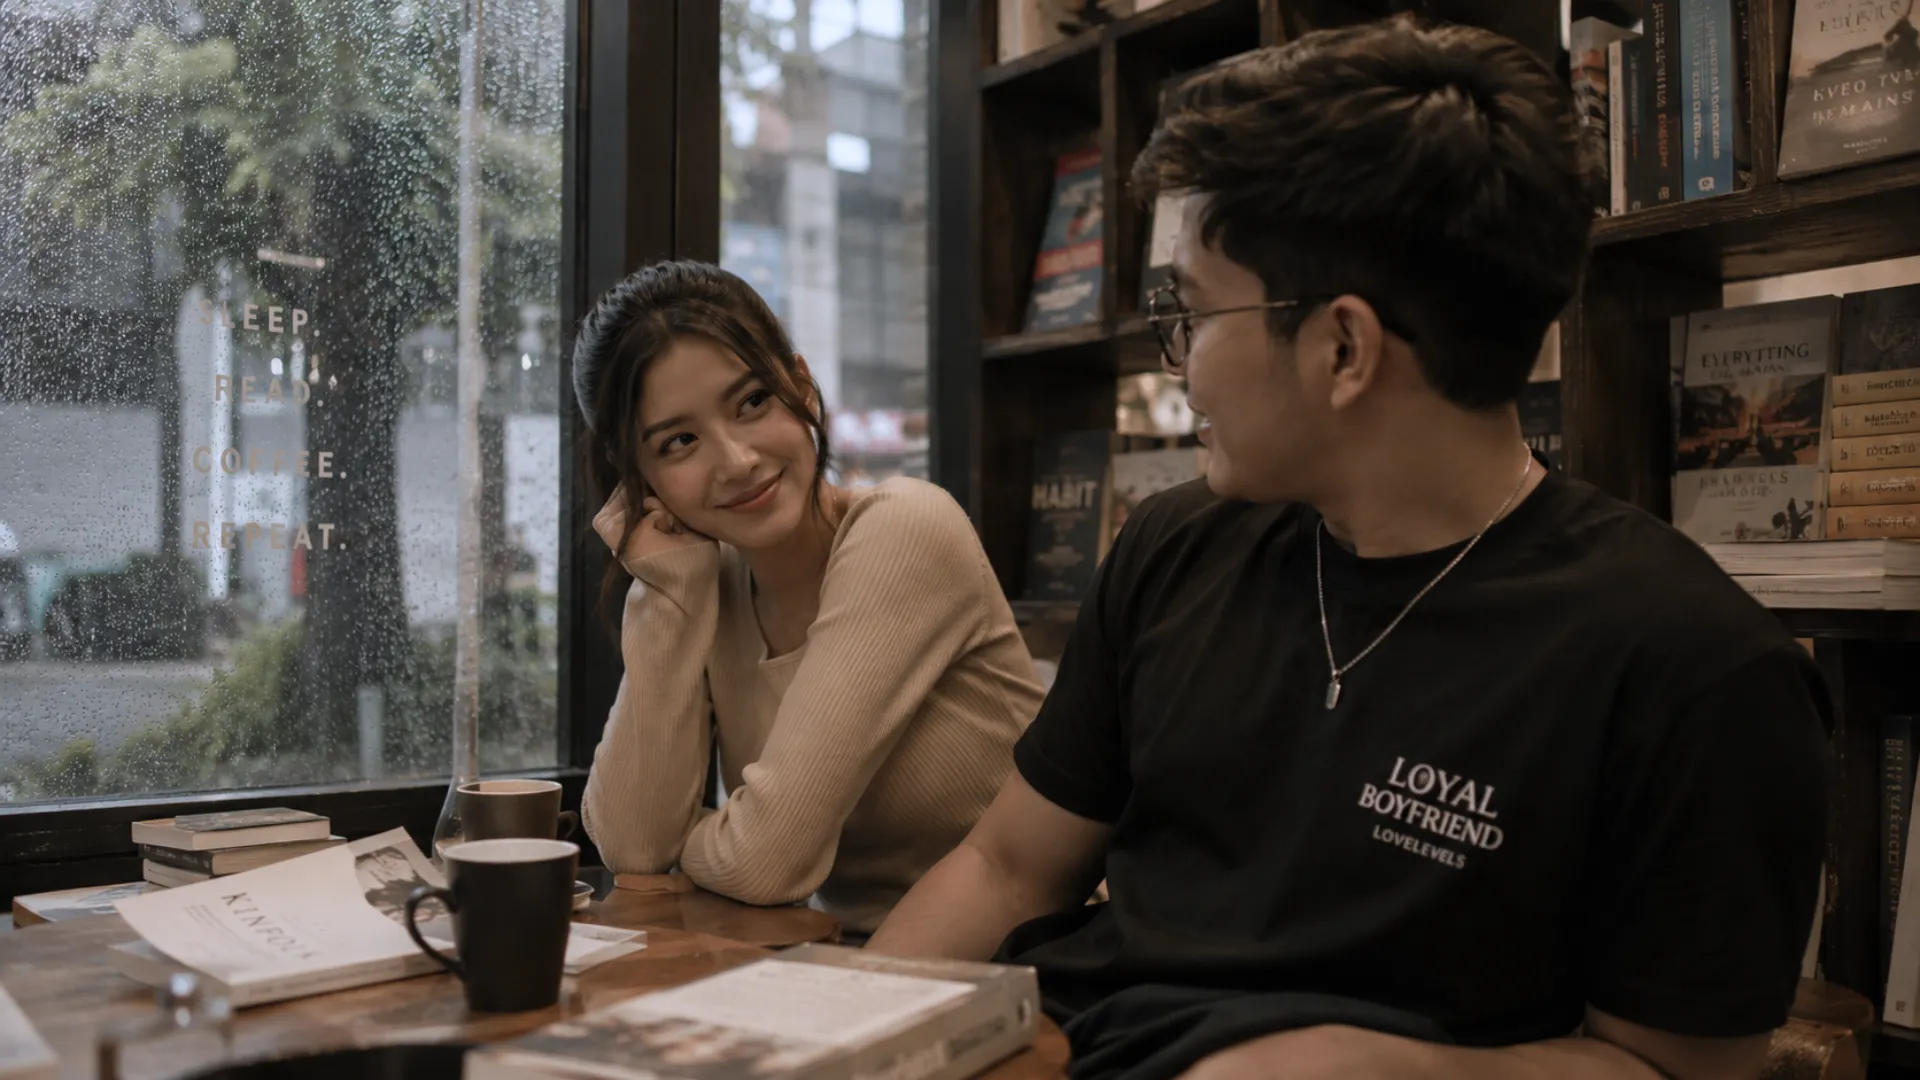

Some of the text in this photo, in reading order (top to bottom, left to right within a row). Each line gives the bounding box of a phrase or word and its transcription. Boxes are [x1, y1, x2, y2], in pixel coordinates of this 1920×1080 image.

[198, 298, 321, 338] SLEEP.
[214, 374, 325, 408] READ.
[192, 445, 348, 480] COFFEE.
[1031, 480, 1099, 511] HABIT
[192, 520, 347, 551] REPEAT.
[1387, 755, 1499, 819] LOYAL
[1357, 782, 1504, 850] BOYFRIEND
[1371, 824, 1468, 870] LOVELEVELS
